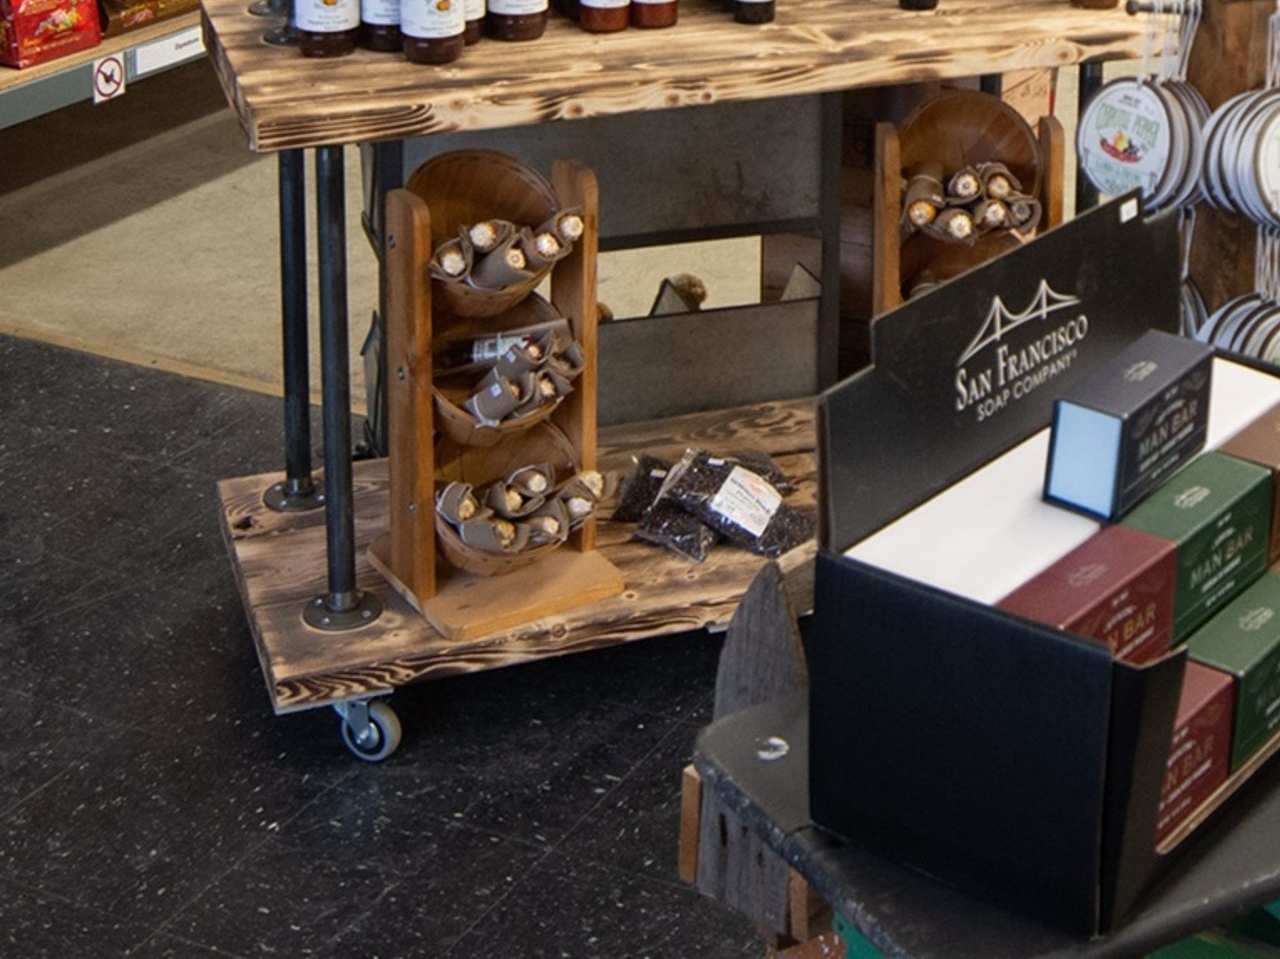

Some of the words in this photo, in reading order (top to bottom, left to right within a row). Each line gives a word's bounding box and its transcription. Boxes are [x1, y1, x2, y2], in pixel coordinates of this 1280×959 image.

[955, 363, 993, 412] SAN
[996, 314, 1089, 386] FRANCISCO
[977, 388, 1010, 422] SOAP
[1013, 355, 1072, 400] COMPANY
[1169, 400, 1198, 434] BAR
[1123, 603, 1157, 639] BAR
